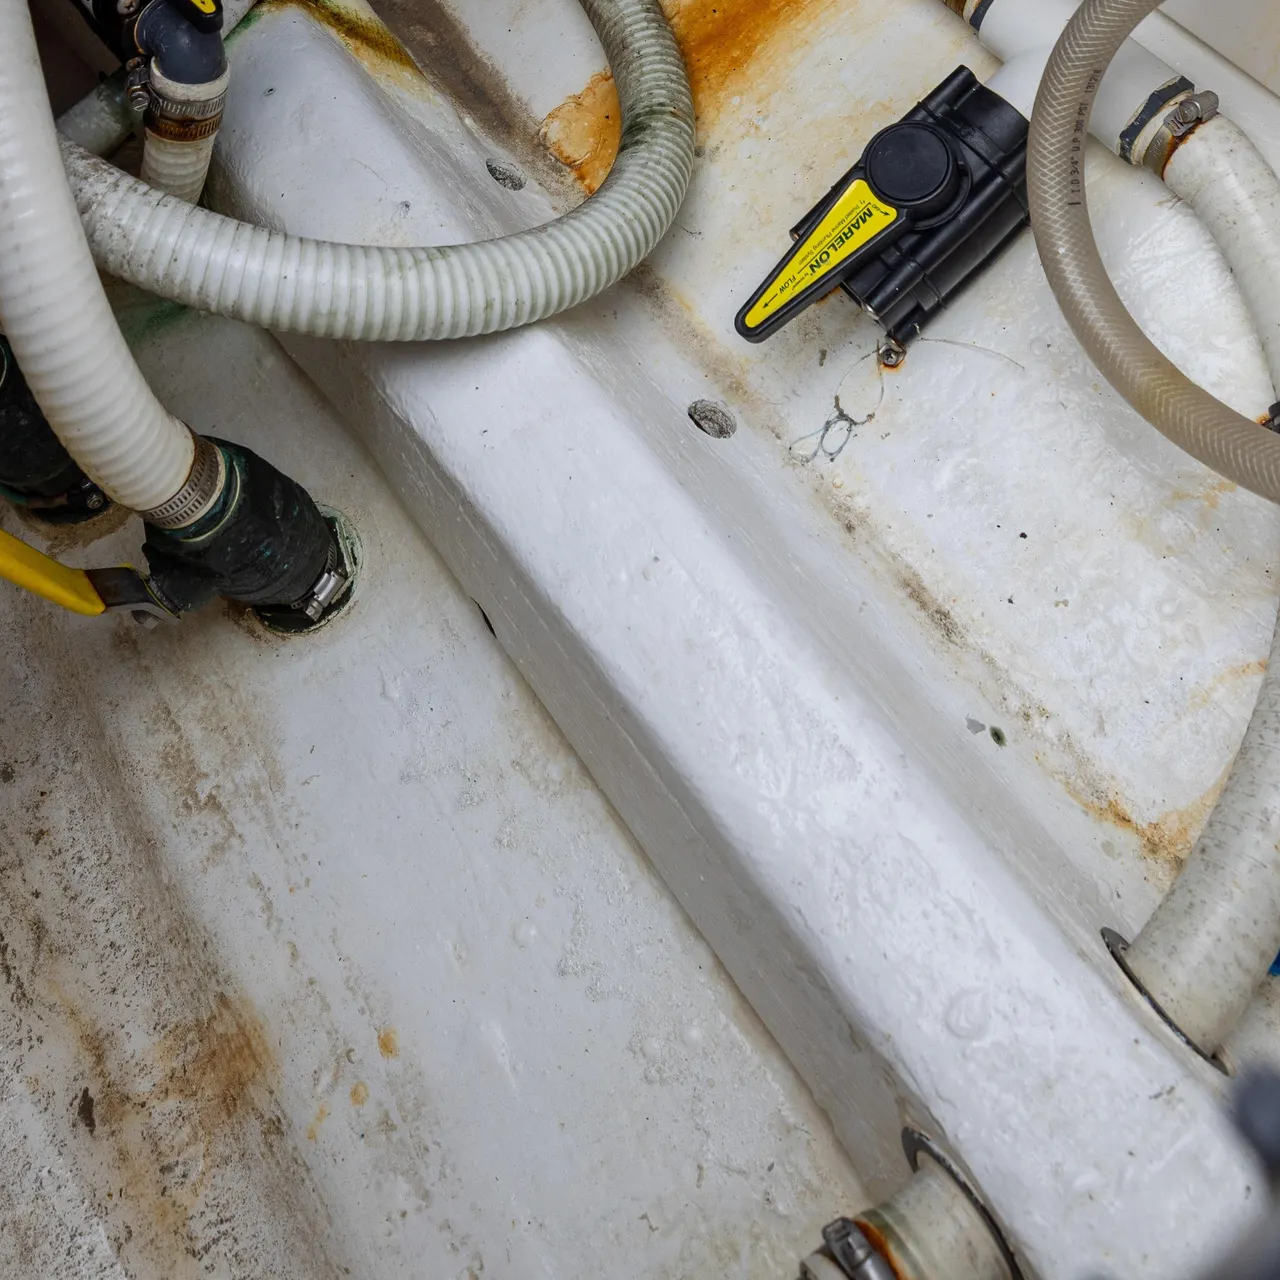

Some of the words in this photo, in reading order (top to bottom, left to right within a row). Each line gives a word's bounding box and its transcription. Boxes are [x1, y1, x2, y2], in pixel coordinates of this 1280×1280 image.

[1077, 102, 1089, 116] PSI
[1074, 118, 1084, 133] 300
[808, 207, 874, 275] MARELON
[779, 275, 797, 294] FLOW
